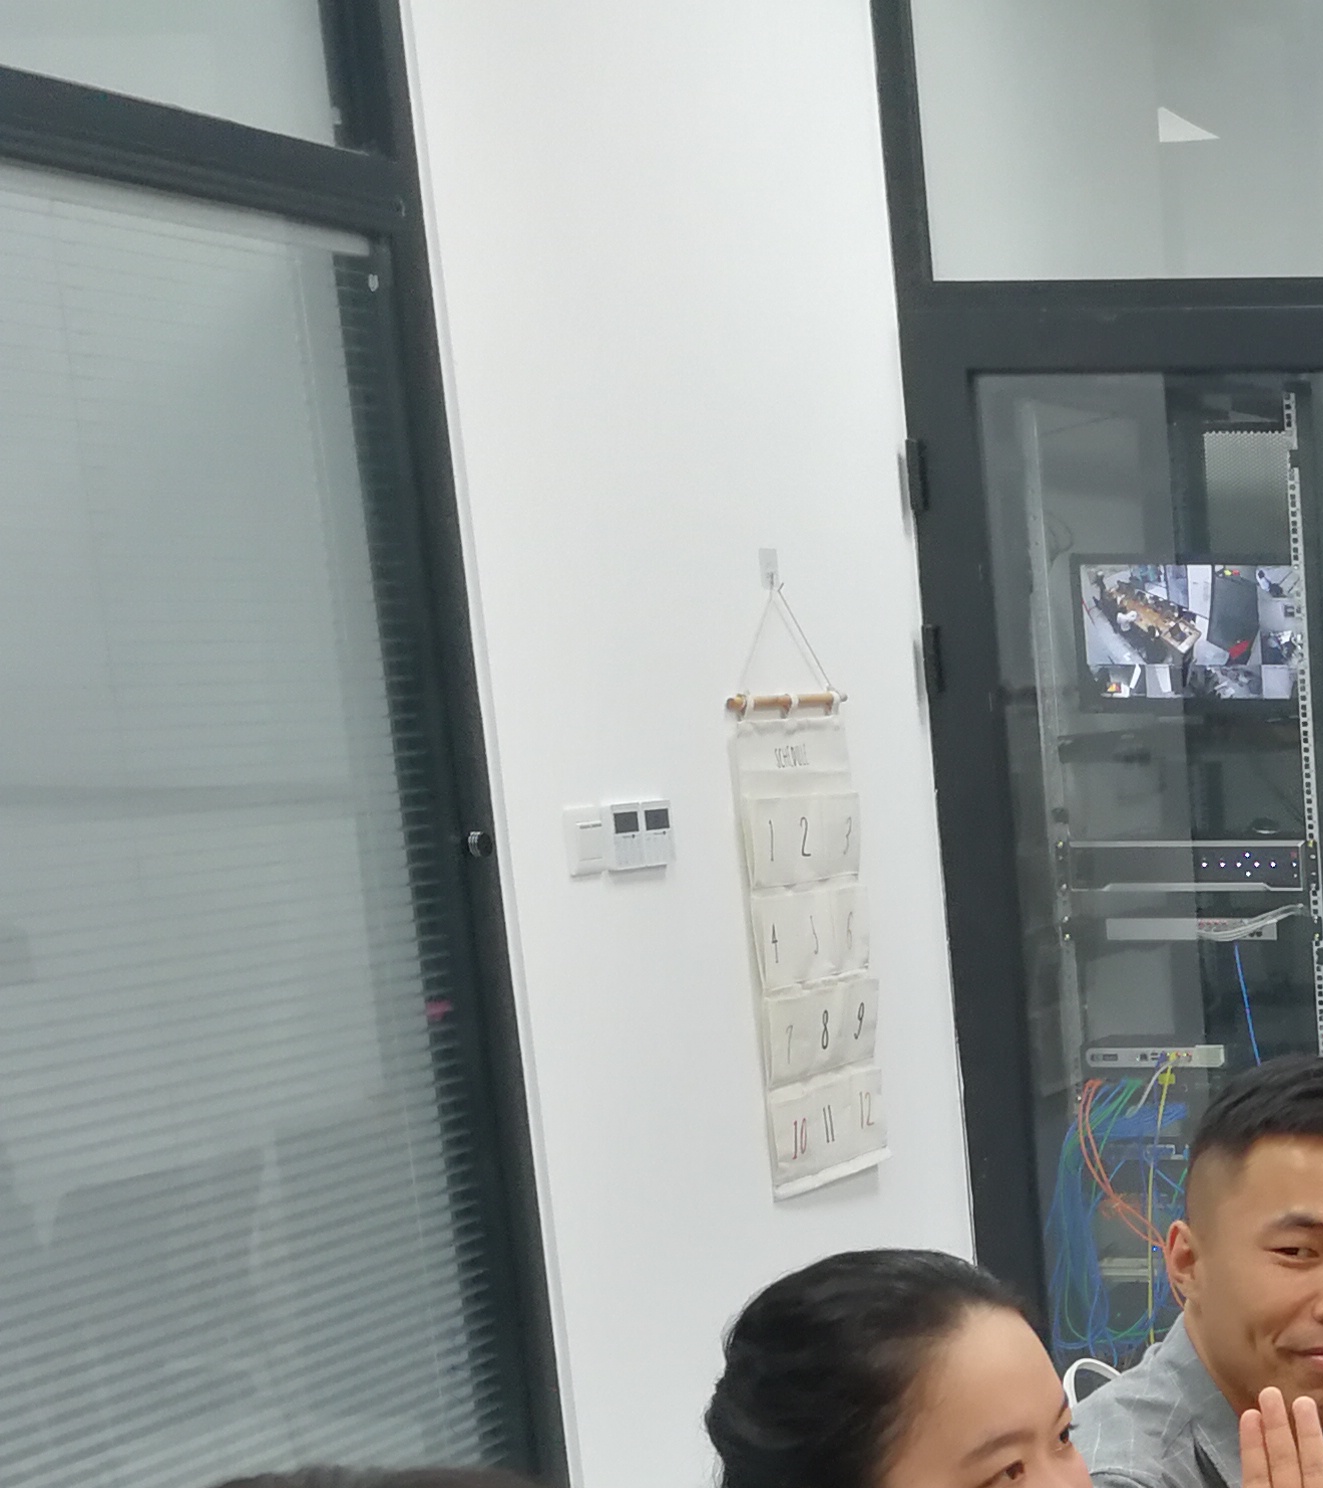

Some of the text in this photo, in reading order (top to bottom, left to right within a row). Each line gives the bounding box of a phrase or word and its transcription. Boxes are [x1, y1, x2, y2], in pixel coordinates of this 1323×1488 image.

[799, 815, 812, 858] 2
[770, 922, 779, 964] 4
[820, 1009, 829, 1050] 8
[853, 1001, 865, 1041] 9
[791, 1090, 876, 1161] 10 11 12
